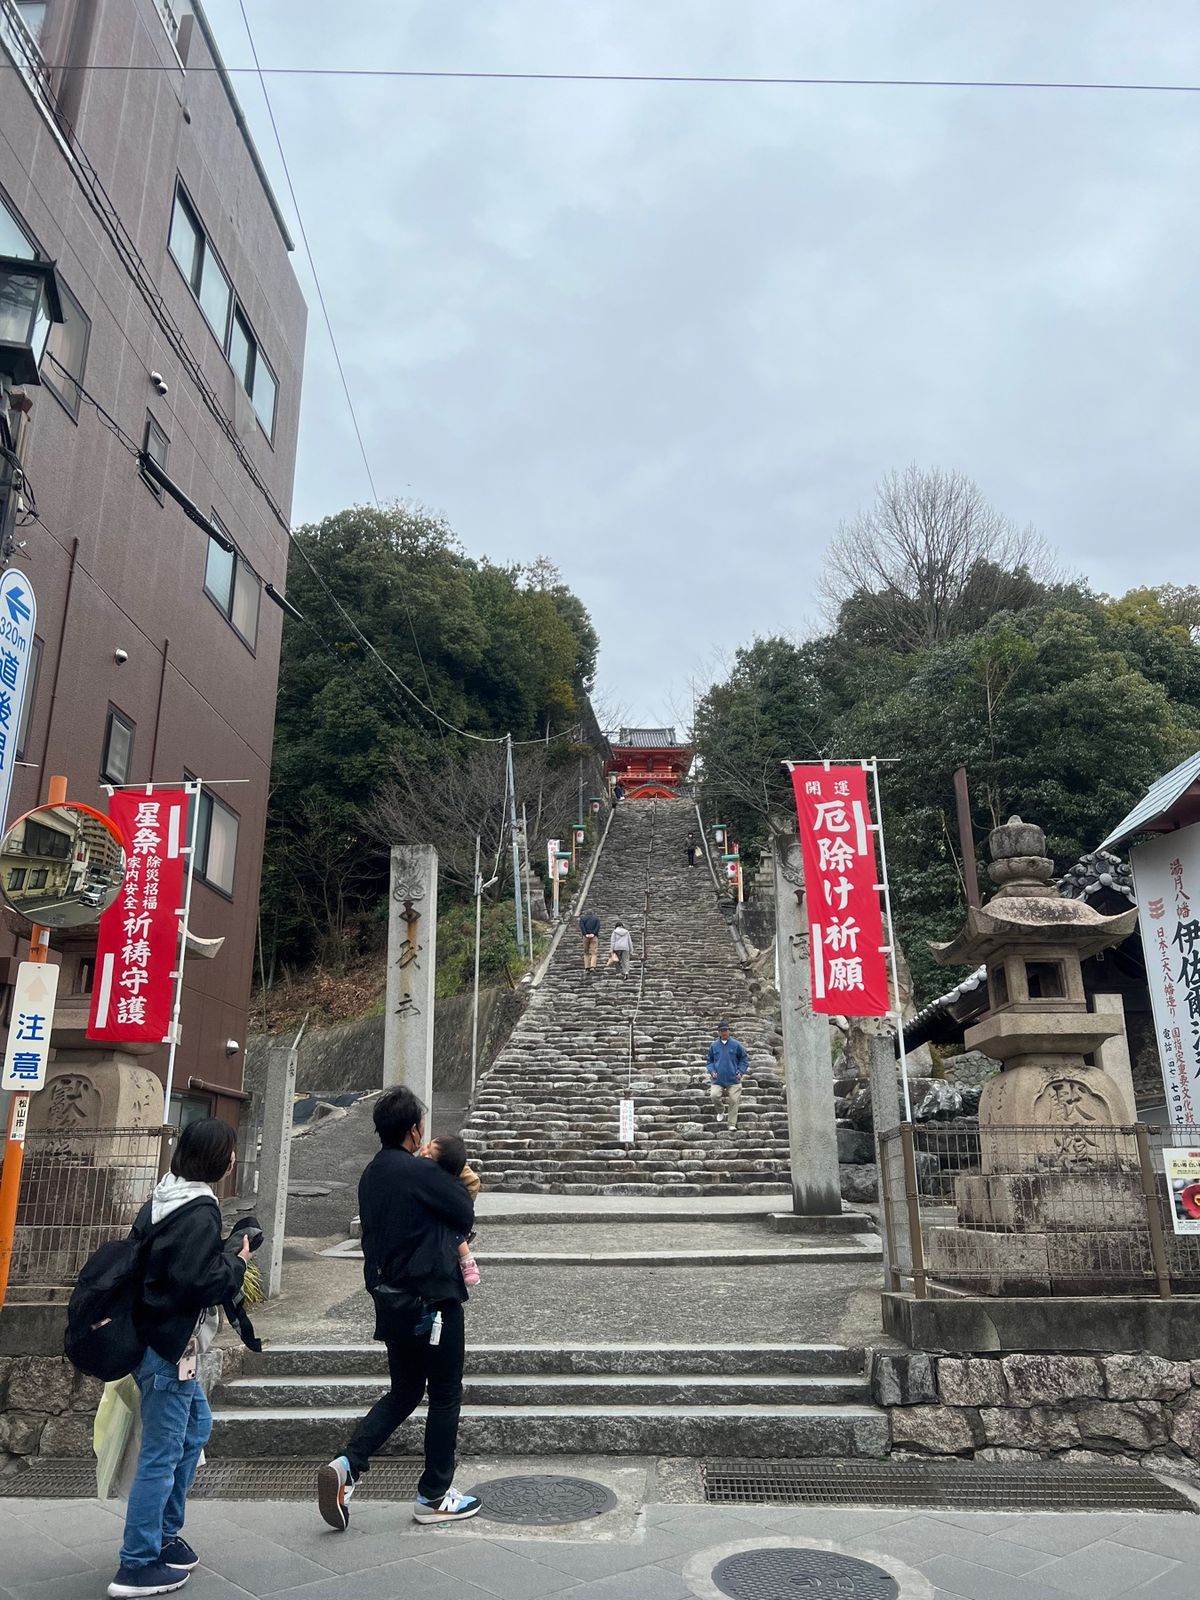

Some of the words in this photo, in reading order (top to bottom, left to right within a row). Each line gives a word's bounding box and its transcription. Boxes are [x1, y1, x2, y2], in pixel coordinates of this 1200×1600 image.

[0, 616, 26, 653] 320m
[805, 780, 851, 796] 開運
[132, 802, 162, 855] 星祭
[123, 855, 141, 910] 家内安全
[142, 855, 162, 910] 除災招福
[813, 800, 865, 992] 厄除け祈願
[10, 1013, 46, 1079] 注意
[16, 1099, 27, 1127] 松山市
